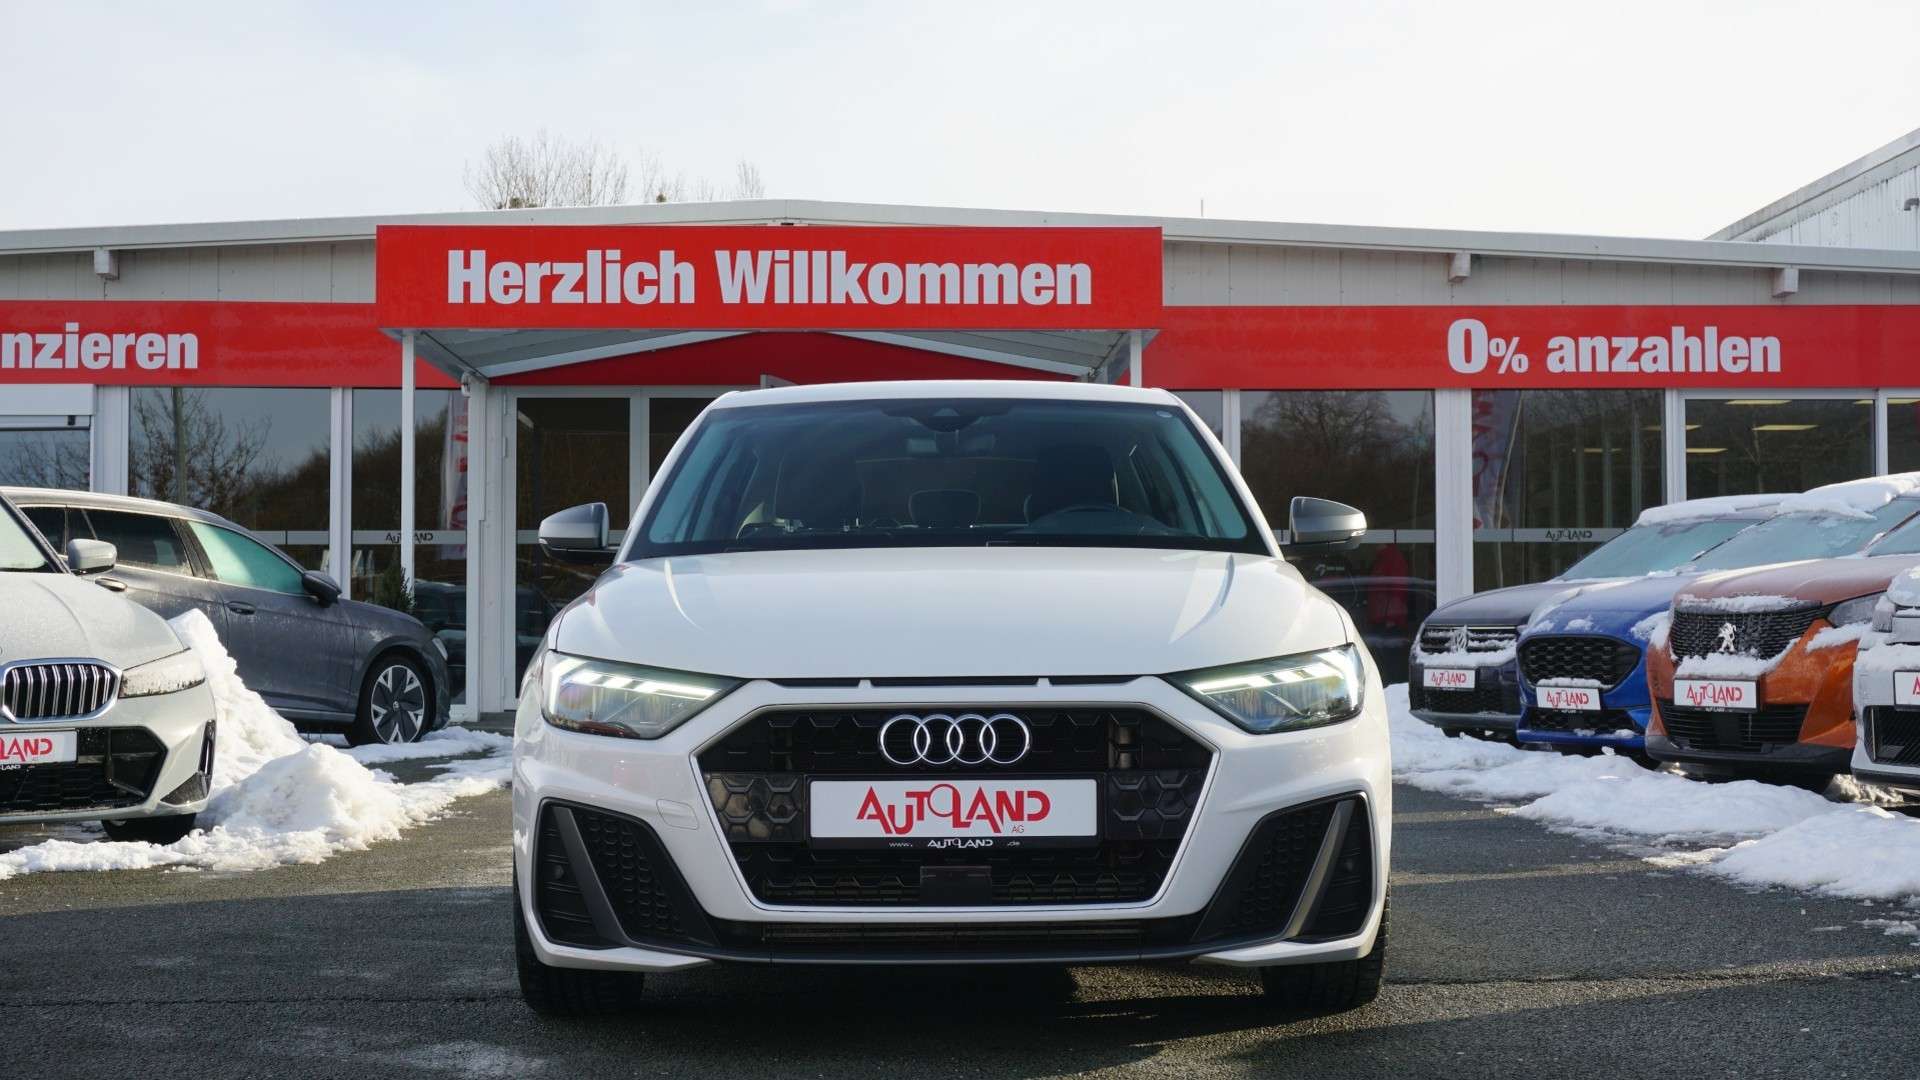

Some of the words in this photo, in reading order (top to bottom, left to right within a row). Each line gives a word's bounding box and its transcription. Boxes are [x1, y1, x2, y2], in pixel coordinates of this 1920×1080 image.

[447, 249, 695, 305] Herzlich
[714, 249, 1092, 306] Willkommen
[1, 322, 199, 370] nzieren
[1447, 318, 1529, 374] 0%
[1546, 325, 1781, 374] anzahlen
[1431, 671, 1468, 686] AUTOLAND
[1546, 689, 1590, 708] AUTOLAND
[1686, 682, 1743, 706] AUTOLAND
[856, 783, 1051, 836] AUTOLAND
[1011, 824, 1025, 834] AG
[927, 838, 993, 849] AUTOLAND
